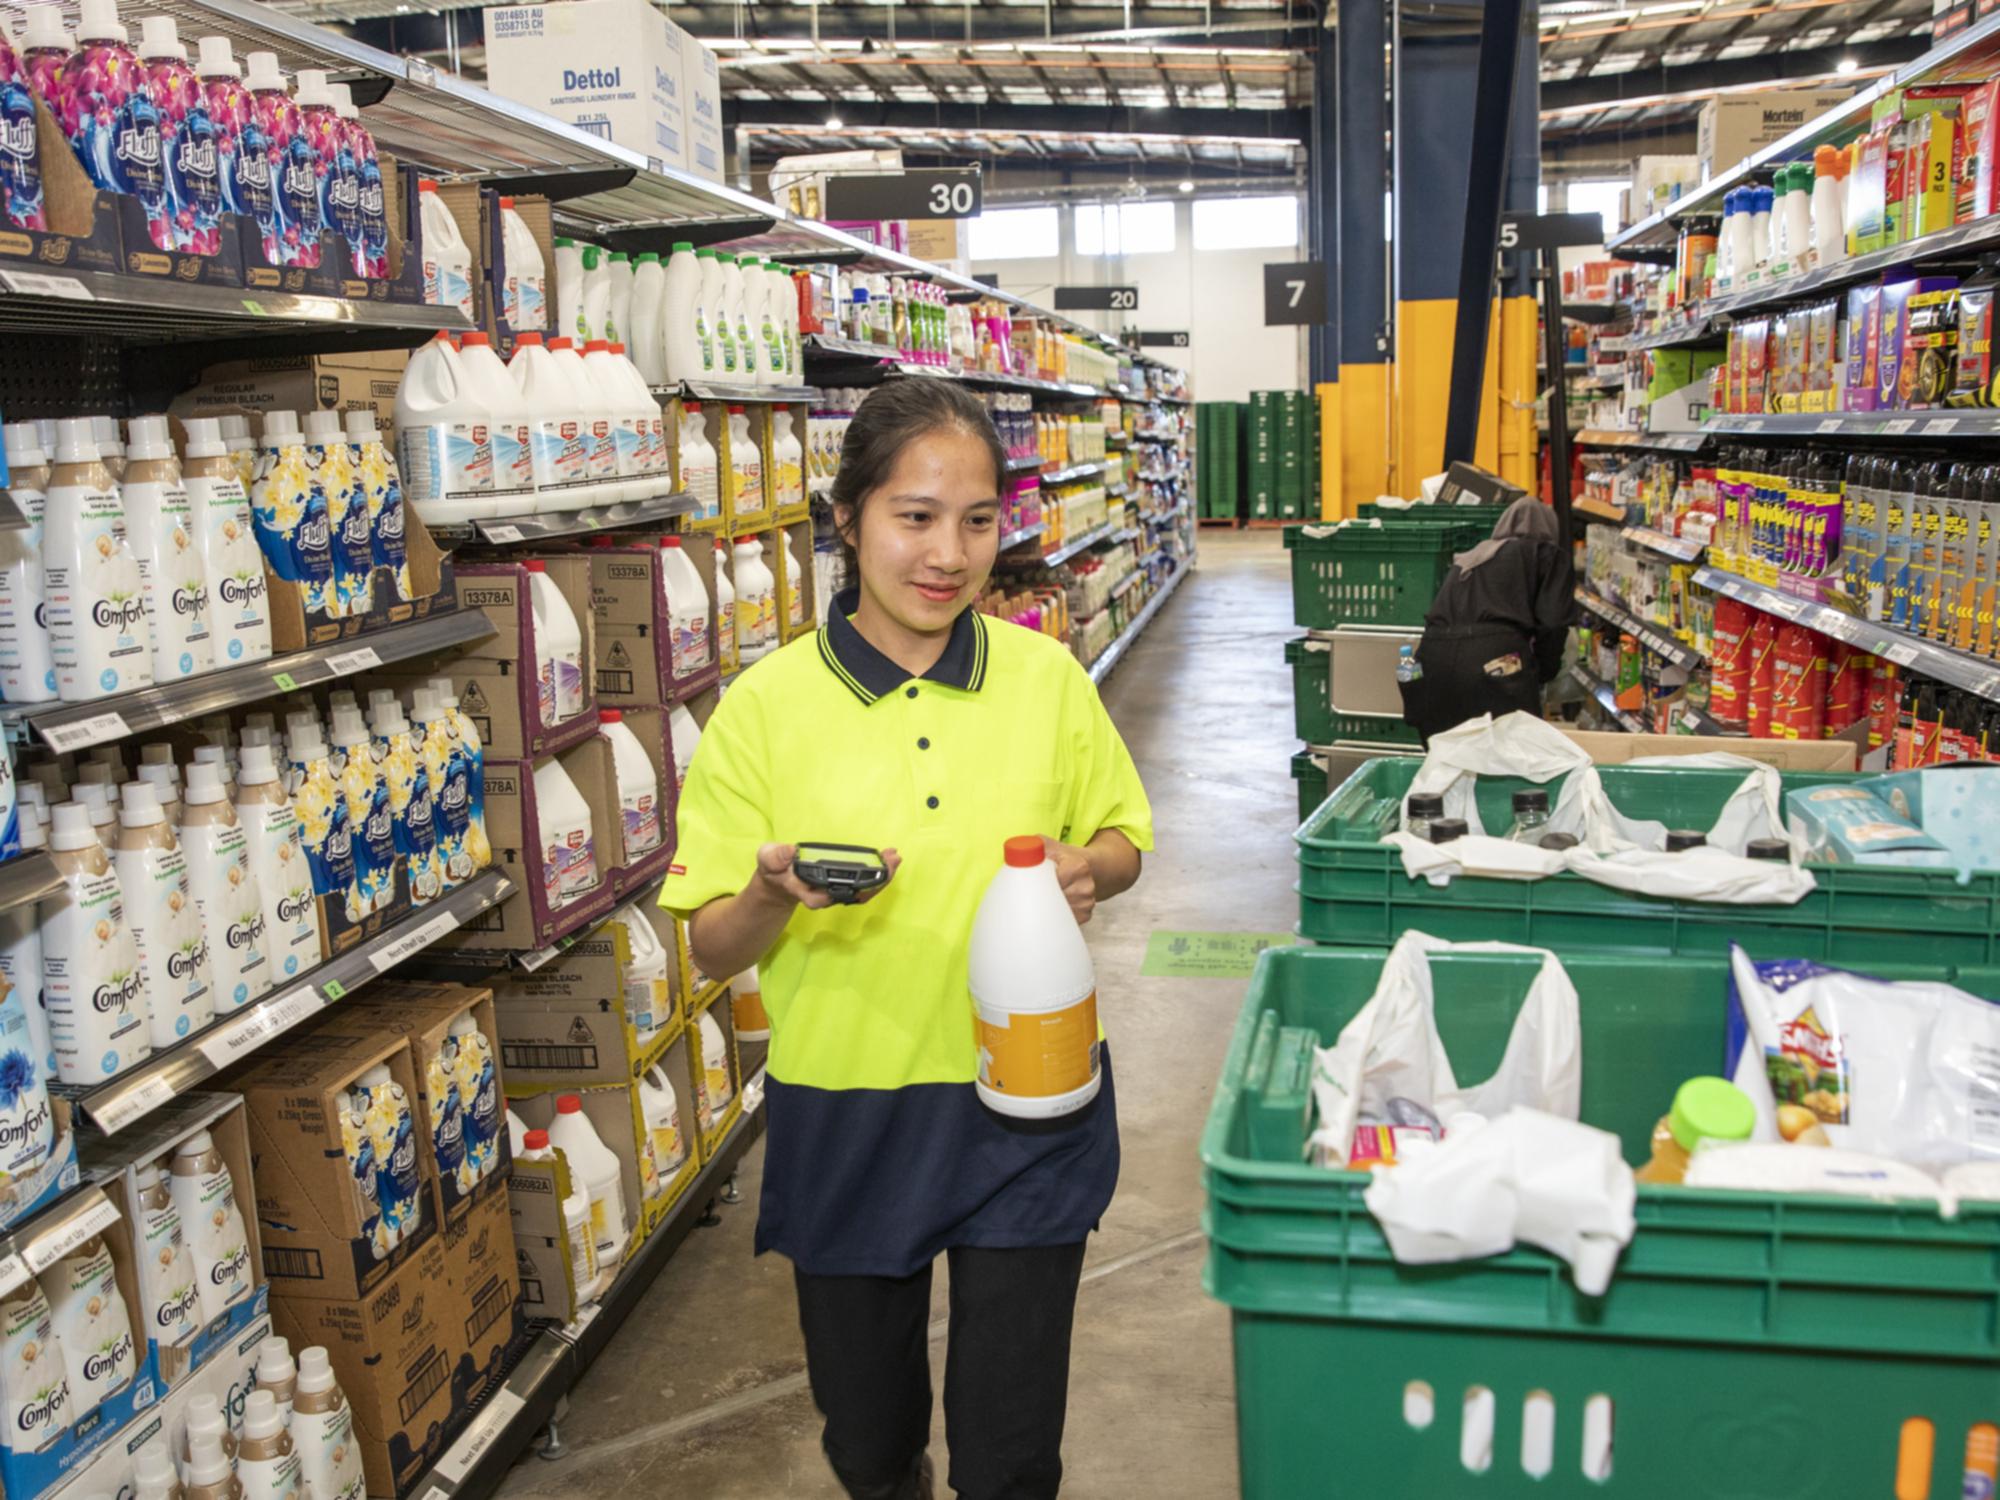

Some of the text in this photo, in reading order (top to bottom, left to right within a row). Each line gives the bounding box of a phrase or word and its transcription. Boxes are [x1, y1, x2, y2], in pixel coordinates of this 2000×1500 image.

[531, 8, 543, 18] AU
[532, 19, 543, 29] CH
[564, 66, 621, 91] Dettol
[587, 93, 617, 103] LAUNDRY
[618, 91, 637, 100] RINSE
[1763, 109, 1803, 124] Mortein
[1934, 161, 1946, 182] 3
[928, 183, 974, 214] 30
[1499, 222, 1519, 248] 5
[1110, 290, 1135, 308] 20
[1286, 279, 1307, 308] 7
[1173, 334, 1187, 346] 10
[195, 393, 275, 405] PREMIUM BLEACH
[213, 383, 256, 394] REGULAR
[609, 567, 646, 577] 13378A
[172, 587, 210, 621] Comfort
[220, 575, 267, 609] Comfort
[467, 592, 511, 604] 13378A
[92, 597, 147, 635] Comfort
[484, 780, 513, 793] 378A
[277, 888, 315, 924] Comfort
[226, 913, 266, 950] Comfort
[167, 941, 208, 980] Comfort
[92, 971, 144, 1015] Comfort
[227, 1030, 249, 1050] Next
[36, 1253, 55, 1267] Next
[72, 1228, 86, 1241] Up
[210, 1245, 250, 1286] Comfort
[157, 1283, 200, 1327] Comfort
[83, 1332, 133, 1381] Comfort
[18, 1380, 70, 1431] Comfort
[77, 1414, 99, 1437] Pure
